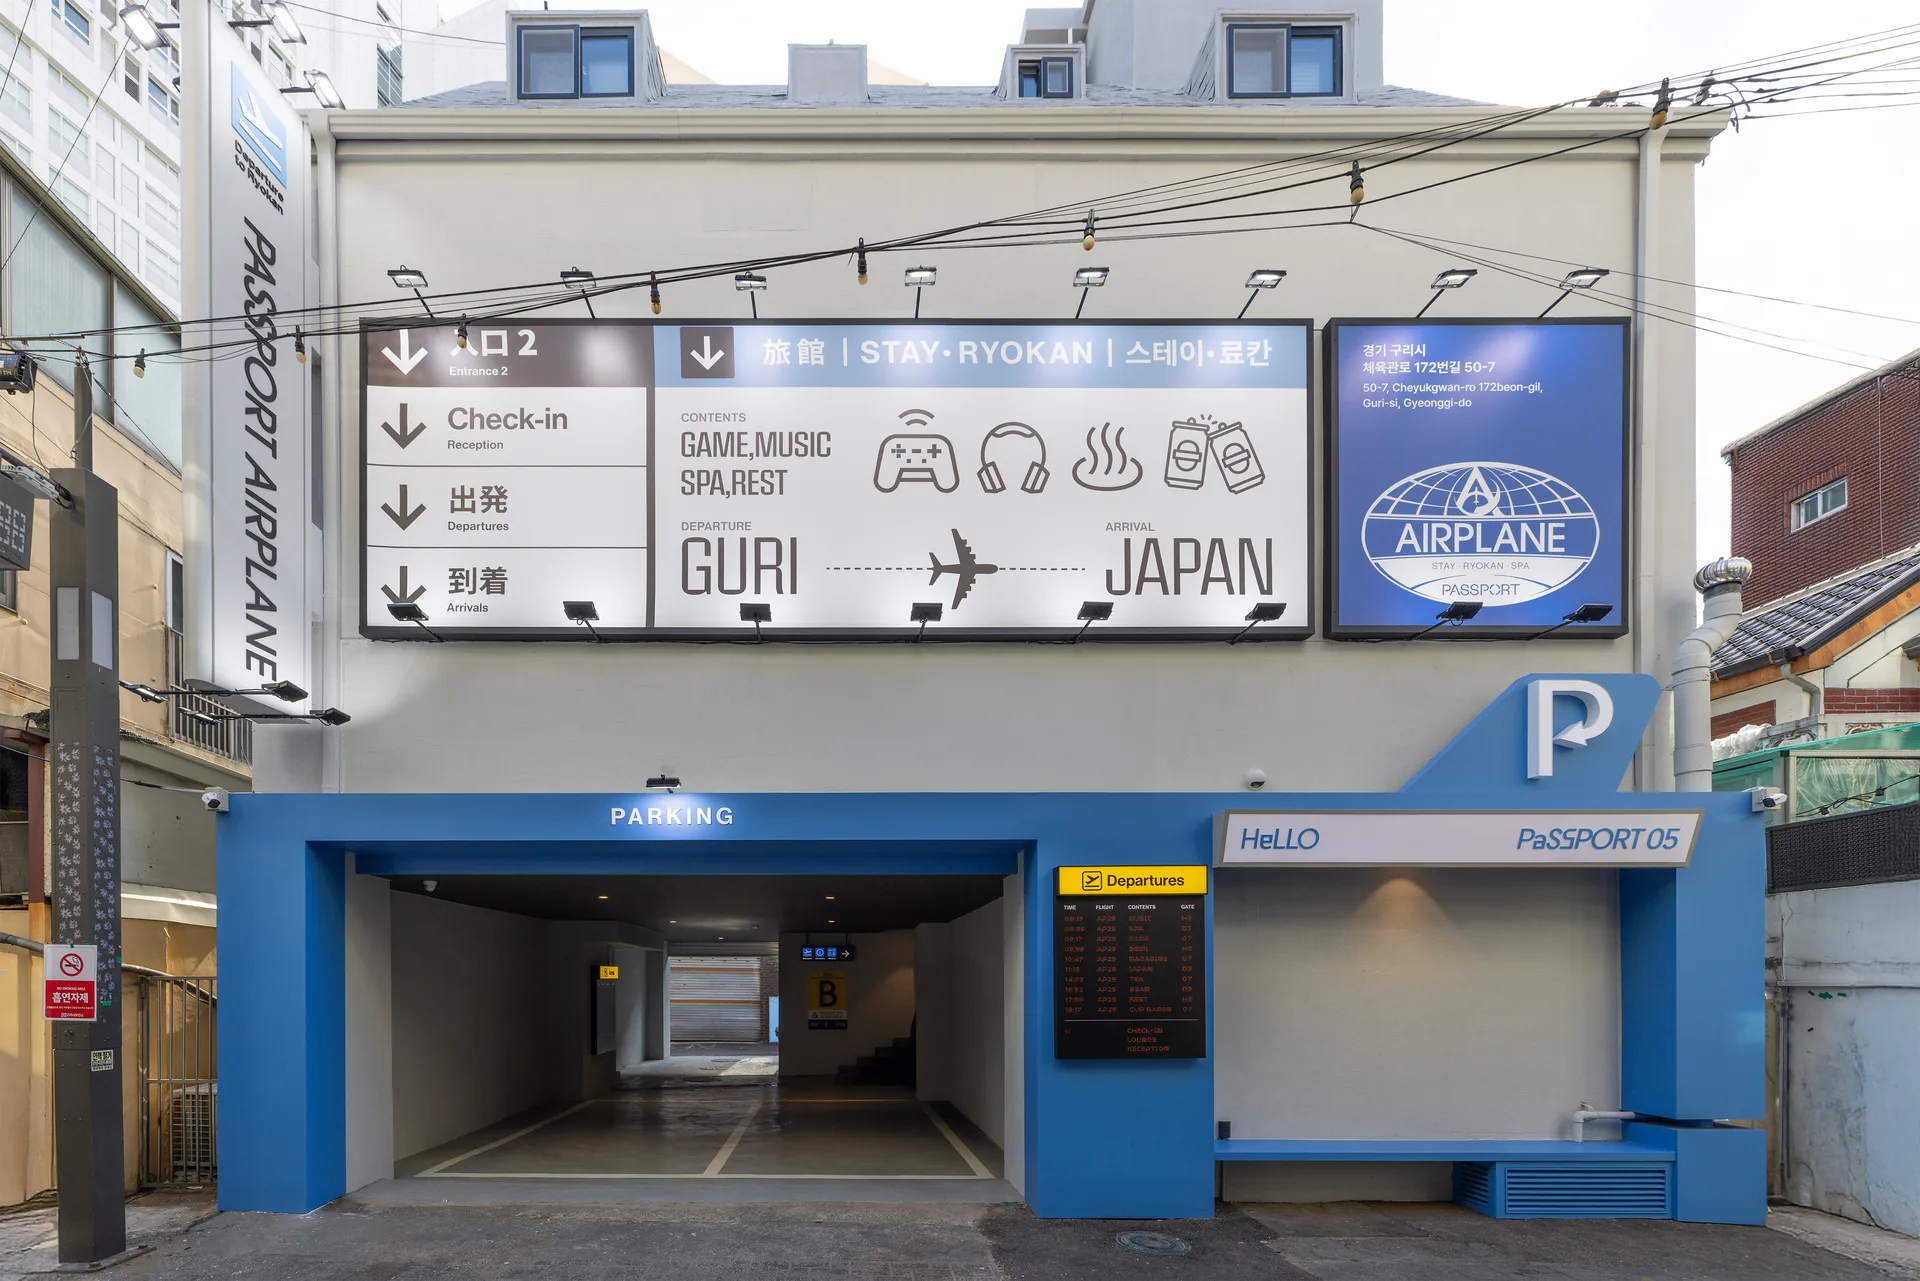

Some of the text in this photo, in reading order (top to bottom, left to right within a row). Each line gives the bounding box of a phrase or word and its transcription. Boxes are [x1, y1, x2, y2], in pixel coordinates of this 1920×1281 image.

[235, 139, 284, 202] Departure
[235, 153, 283, 215] to Ryokan
[517, 329, 538, 356] 2
[1363, 344, 1426, 358] 경기 구리시
[763, 338, 825, 366] 旅館
[449, 366, 508, 376] Entrance 2
[1363, 361, 1495, 375] 체육관로 172번길 50-7
[1363, 382, 1543, 395] 50-7, Cheyukgwan-ro 172beon-gil,
[1363, 398, 1472, 409] Guri-si, Gyeonggi-do
[447, 406, 568, 431] Check-in
[681, 412, 747, 423] CONTENTS
[243, 216, 278, 682] PASSPORT AIRPLANE
[447, 439, 504, 453] Reception
[681, 431, 831, 461] GAME,MUSIC
[681, 469, 787, 499] SPA,REST
[450, 485, 509, 515] 出発
[447, 521, 509, 534] Departures
[681, 521, 752, 531] DEPARTURE
[1105, 522, 1155, 532] ARRIVAL
[1395, 522, 1565, 553] AIRPLANE
[681, 537, 797, 595] GURI
[1106, 537, 1273, 596] JAPAN
[1432, 562, 1530, 570] STAY RYOKAN SPA
[447, 566, 508, 596] 到着
[1442, 583, 1520, 596] PASSPORT
[447, 602, 489, 613] Arrivals
[611, 807, 733, 825] PARKING
[1647, 827, 1681, 850] 05
[1107, 874, 1184, 889] Departures
[52, 992, 89, 1003] 흡연자제
[820, 980, 837, 1007] B
